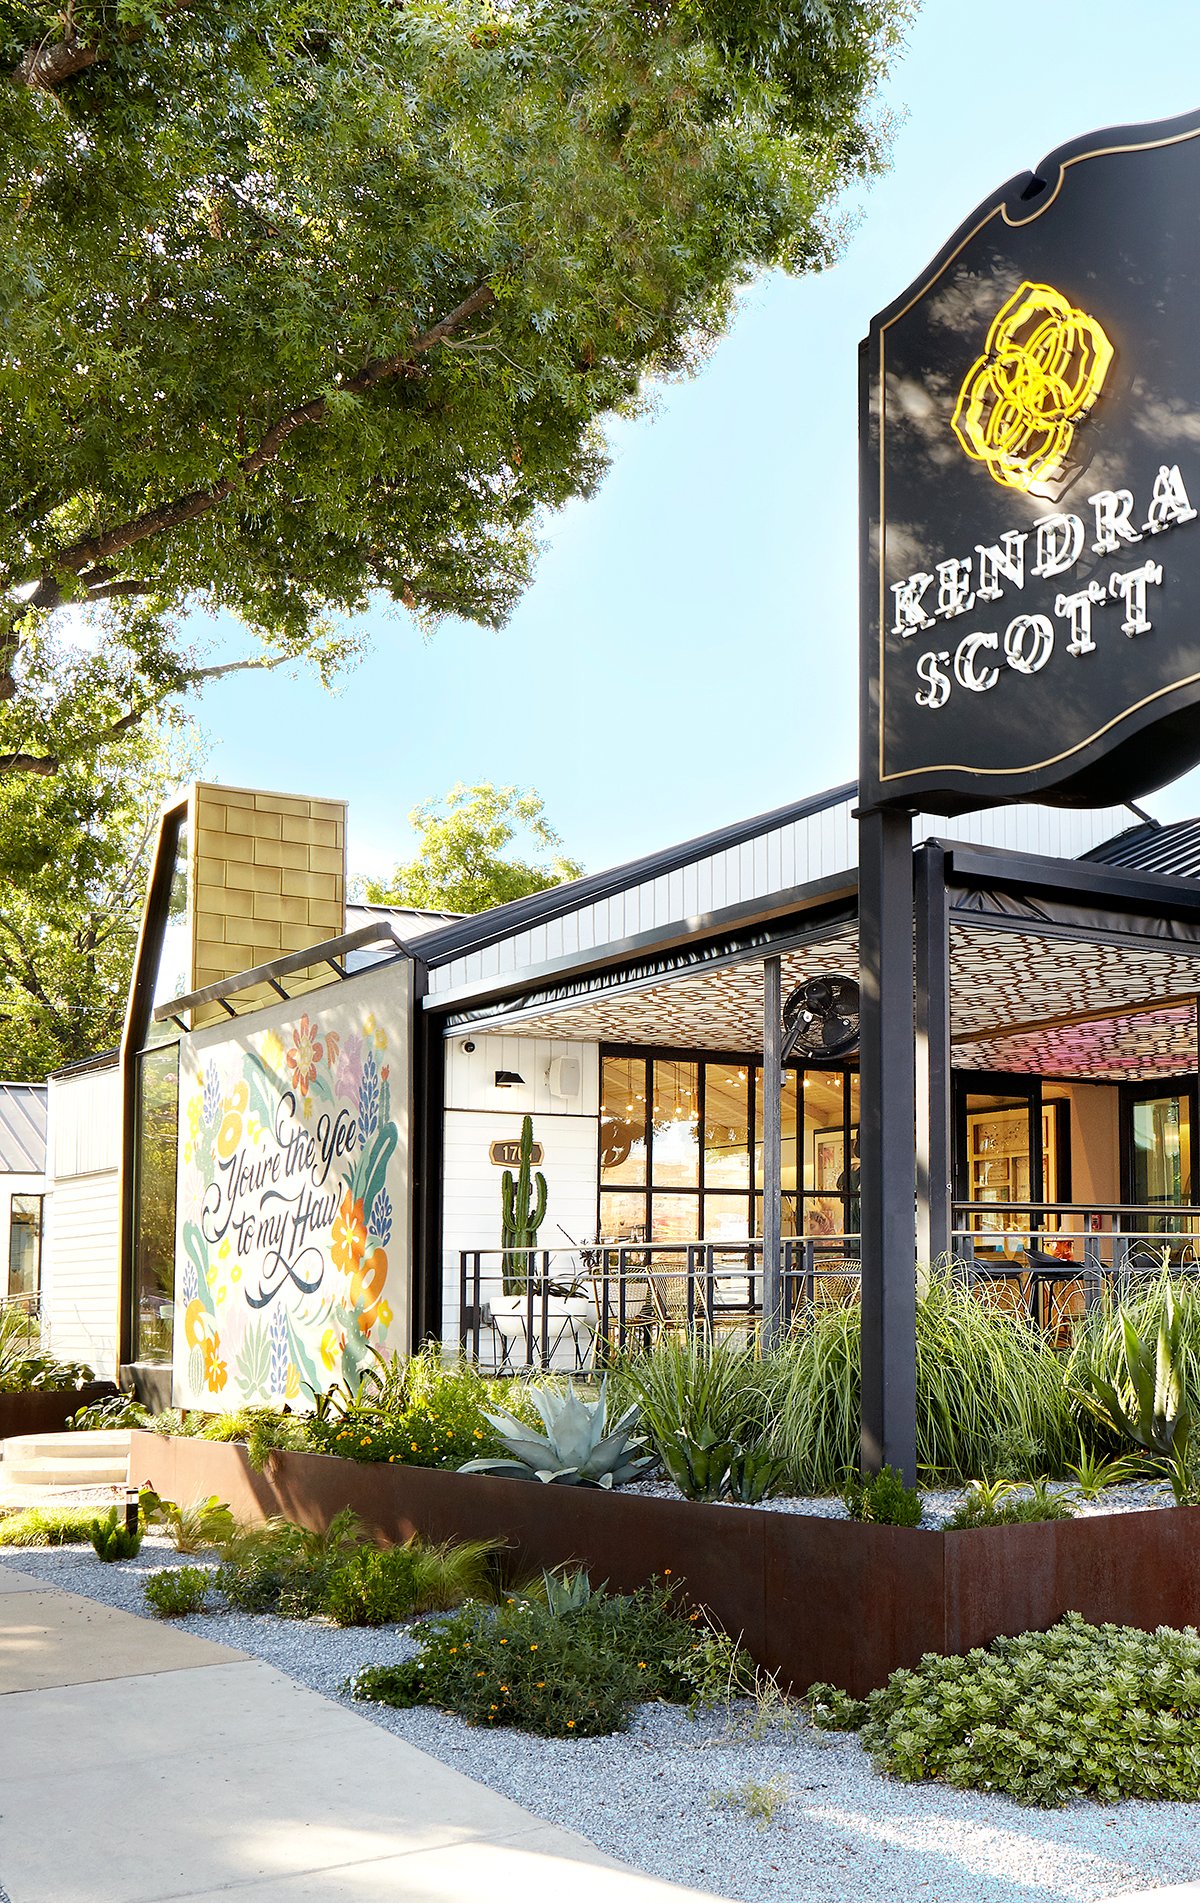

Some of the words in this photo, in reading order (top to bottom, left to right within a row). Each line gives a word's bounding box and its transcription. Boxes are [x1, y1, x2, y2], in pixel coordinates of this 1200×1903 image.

[890, 464, 1198, 638] KENDRA
[915, 559, 1163, 709] SCOTT
[276, 1092, 315, 1178] the
[312, 1109, 357, 1188] Yee
[502, 1145, 532, 1161] 17
[232, 1211, 256, 1257] to
[260, 1181, 342, 1261] Haw
